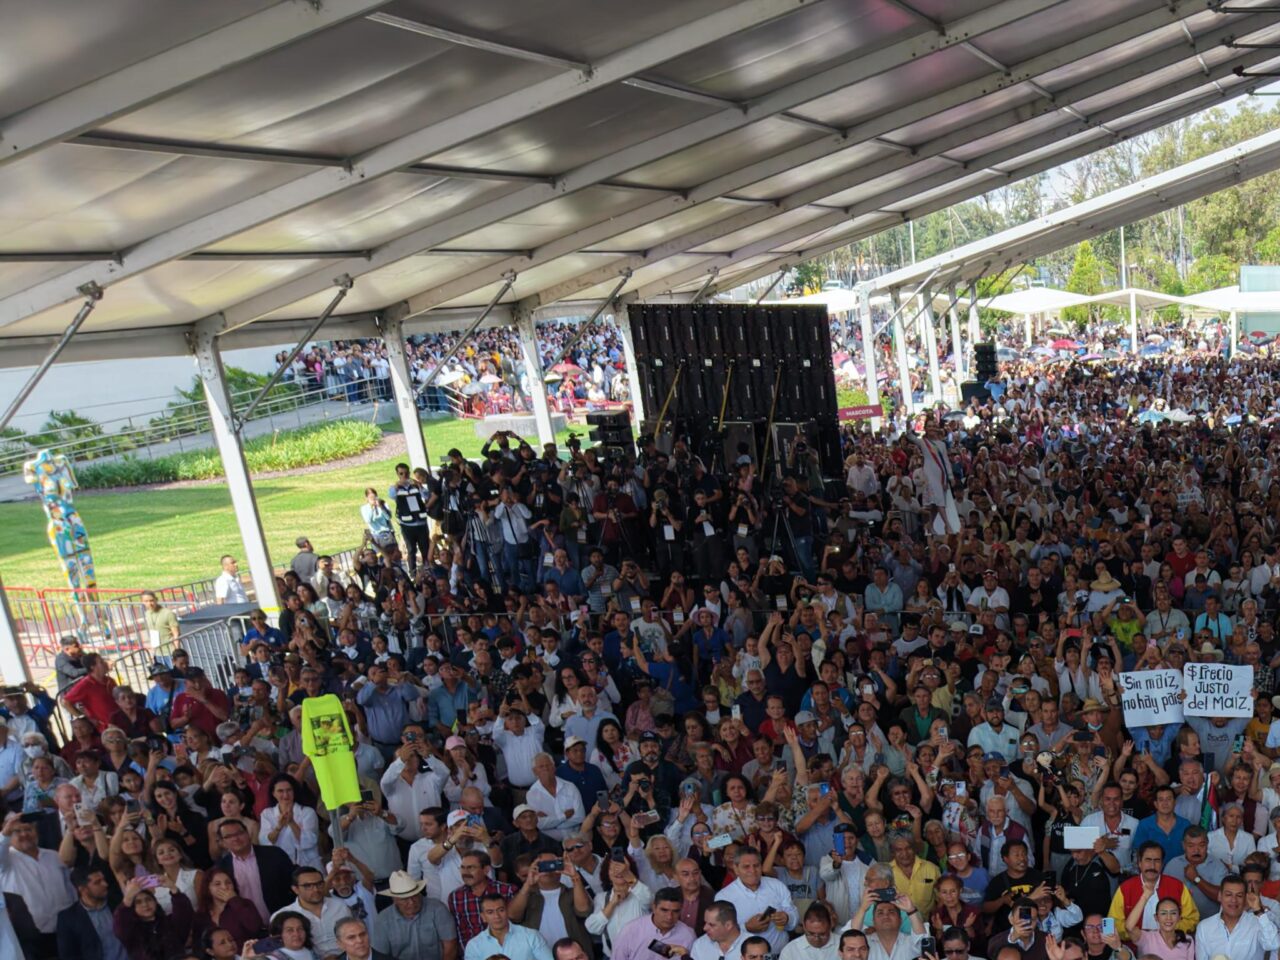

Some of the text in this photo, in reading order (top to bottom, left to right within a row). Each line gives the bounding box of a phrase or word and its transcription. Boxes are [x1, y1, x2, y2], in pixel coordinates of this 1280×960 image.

[1199, 664, 1233, 681] Precio
[1136, 692, 1160, 714] hay
[1187, 690, 1251, 711] del Maíz.
